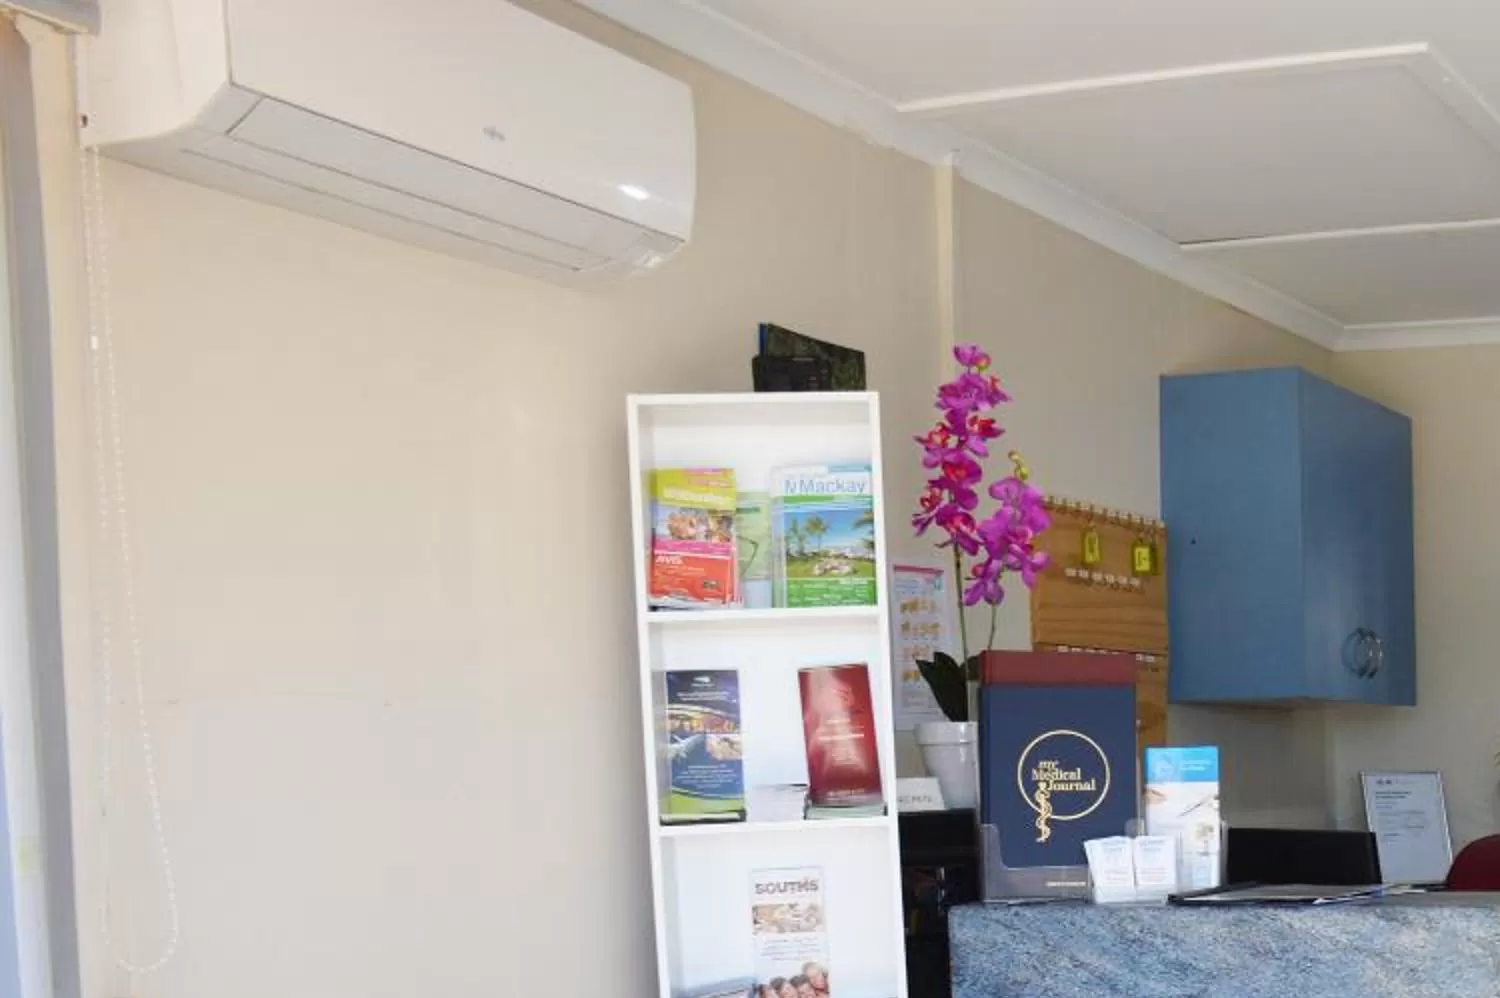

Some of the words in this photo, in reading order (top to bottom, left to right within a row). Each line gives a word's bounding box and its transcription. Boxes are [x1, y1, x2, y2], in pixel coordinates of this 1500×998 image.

[1031, 767, 1081, 781] Medical
[1047, 778, 1096, 791] Journal
[754, 878, 819, 895] SOUTHS
